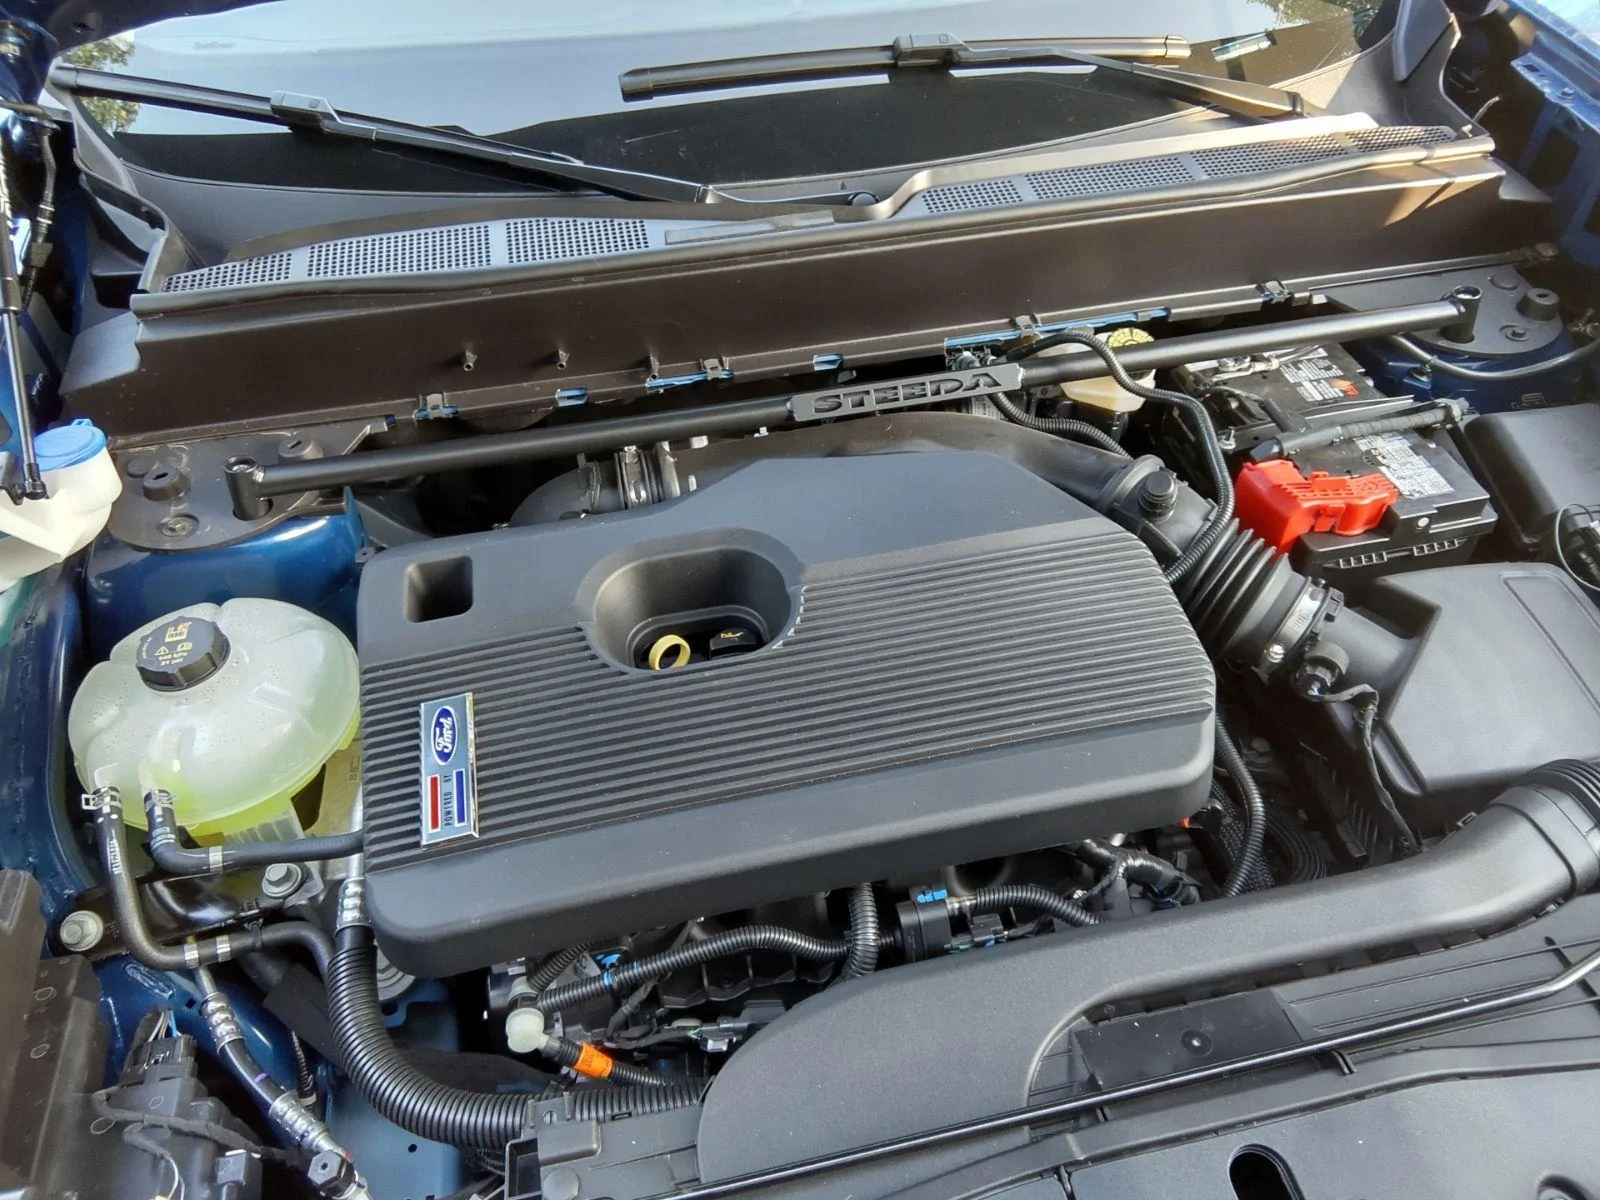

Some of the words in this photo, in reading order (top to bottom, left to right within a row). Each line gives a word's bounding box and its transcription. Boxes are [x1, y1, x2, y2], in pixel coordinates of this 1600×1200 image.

[813, 372, 1002, 414] STEEDA
[435, 717, 453, 754] Ford
[443, 774, 452, 783] BY
[443, 791, 453, 827] POWERED
